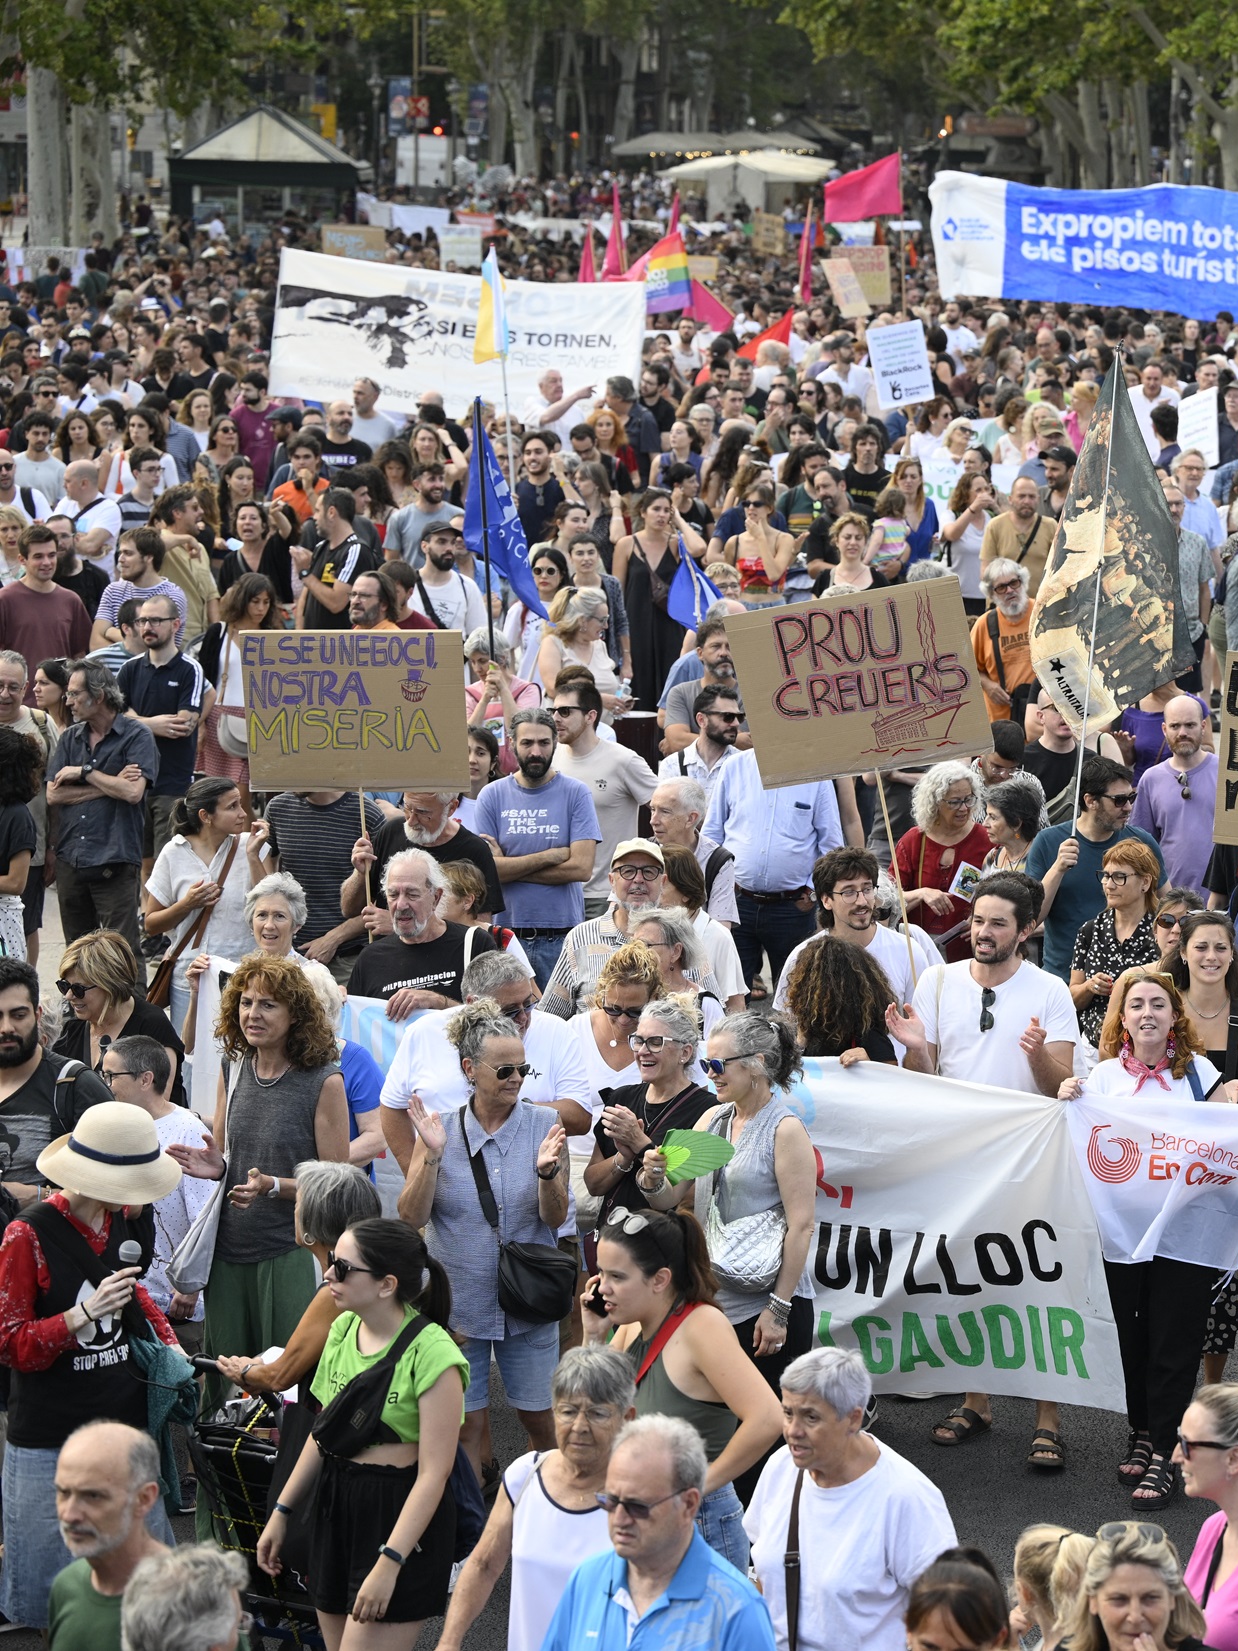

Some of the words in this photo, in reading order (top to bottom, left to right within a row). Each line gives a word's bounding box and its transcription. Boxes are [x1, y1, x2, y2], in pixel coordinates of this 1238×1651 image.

[1020, 206, 1186, 248] Expropiem
[1071, 241, 1158, 273] pisos
[437, 319, 458, 337] SI
[524, 332, 617, 350] TORNEN,
[242, 635, 276, 668] EL
[771, 597, 903, 679] PROU
[249, 669, 371, 710] NOSTRA
[771, 652, 971, 720] CREUERS
[501, 809, 548, 818] #SAVE
[506, 824, 560, 835] ARCTIC
[508, 818, 537, 826] THE
[1148, 1155, 1181, 1181] En
[1185, 1161, 1238, 1187] Com
[814, 1221, 893, 1298] UN
[903, 1219, 1063, 1296] LLOC
[851, 1304, 1090, 1380] GAUDIR
[73, 1353, 98, 1371] STOP
